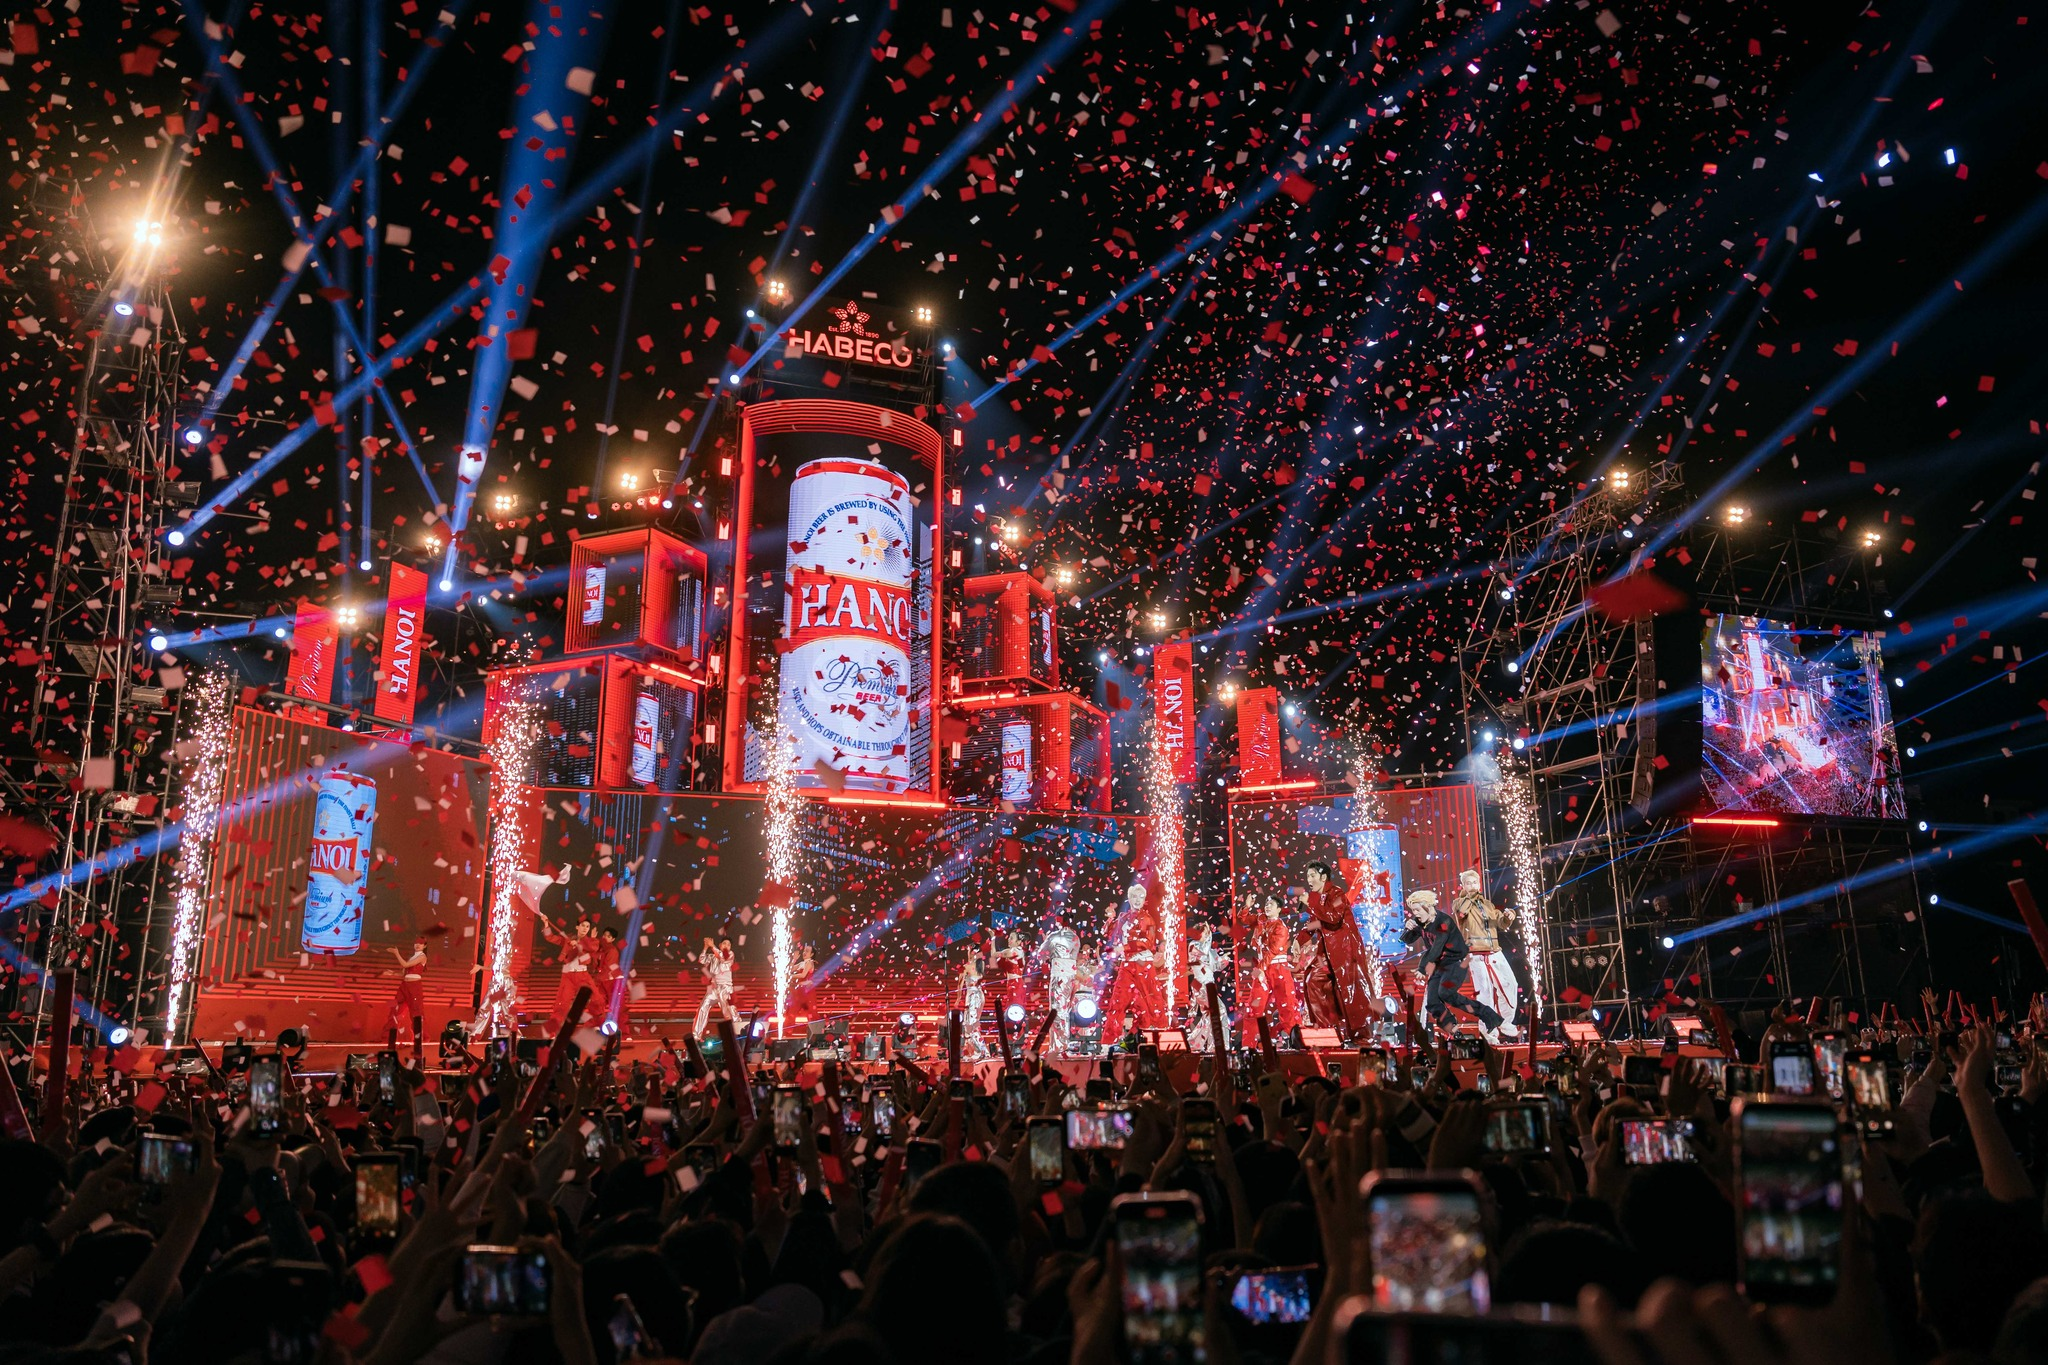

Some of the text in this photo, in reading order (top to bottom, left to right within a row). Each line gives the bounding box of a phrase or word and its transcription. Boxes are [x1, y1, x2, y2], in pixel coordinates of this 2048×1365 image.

[789, 328, 912, 368] HABECO
[865, 331, 880, 339] 1890
[812, 512, 829, 529] BEER
[826, 507, 836, 517] IS
[834, 500, 868, 512] BREWED
[868, 501, 878, 510] BY
[879, 504, 898, 522] USING
[389, 606, 416, 694] HANOI
[855, 691, 882, 702] BEER
[796, 703, 810, 719] AND
[806, 715, 825, 733] HOPS
[822, 728, 871, 751] OBTAINABLE
